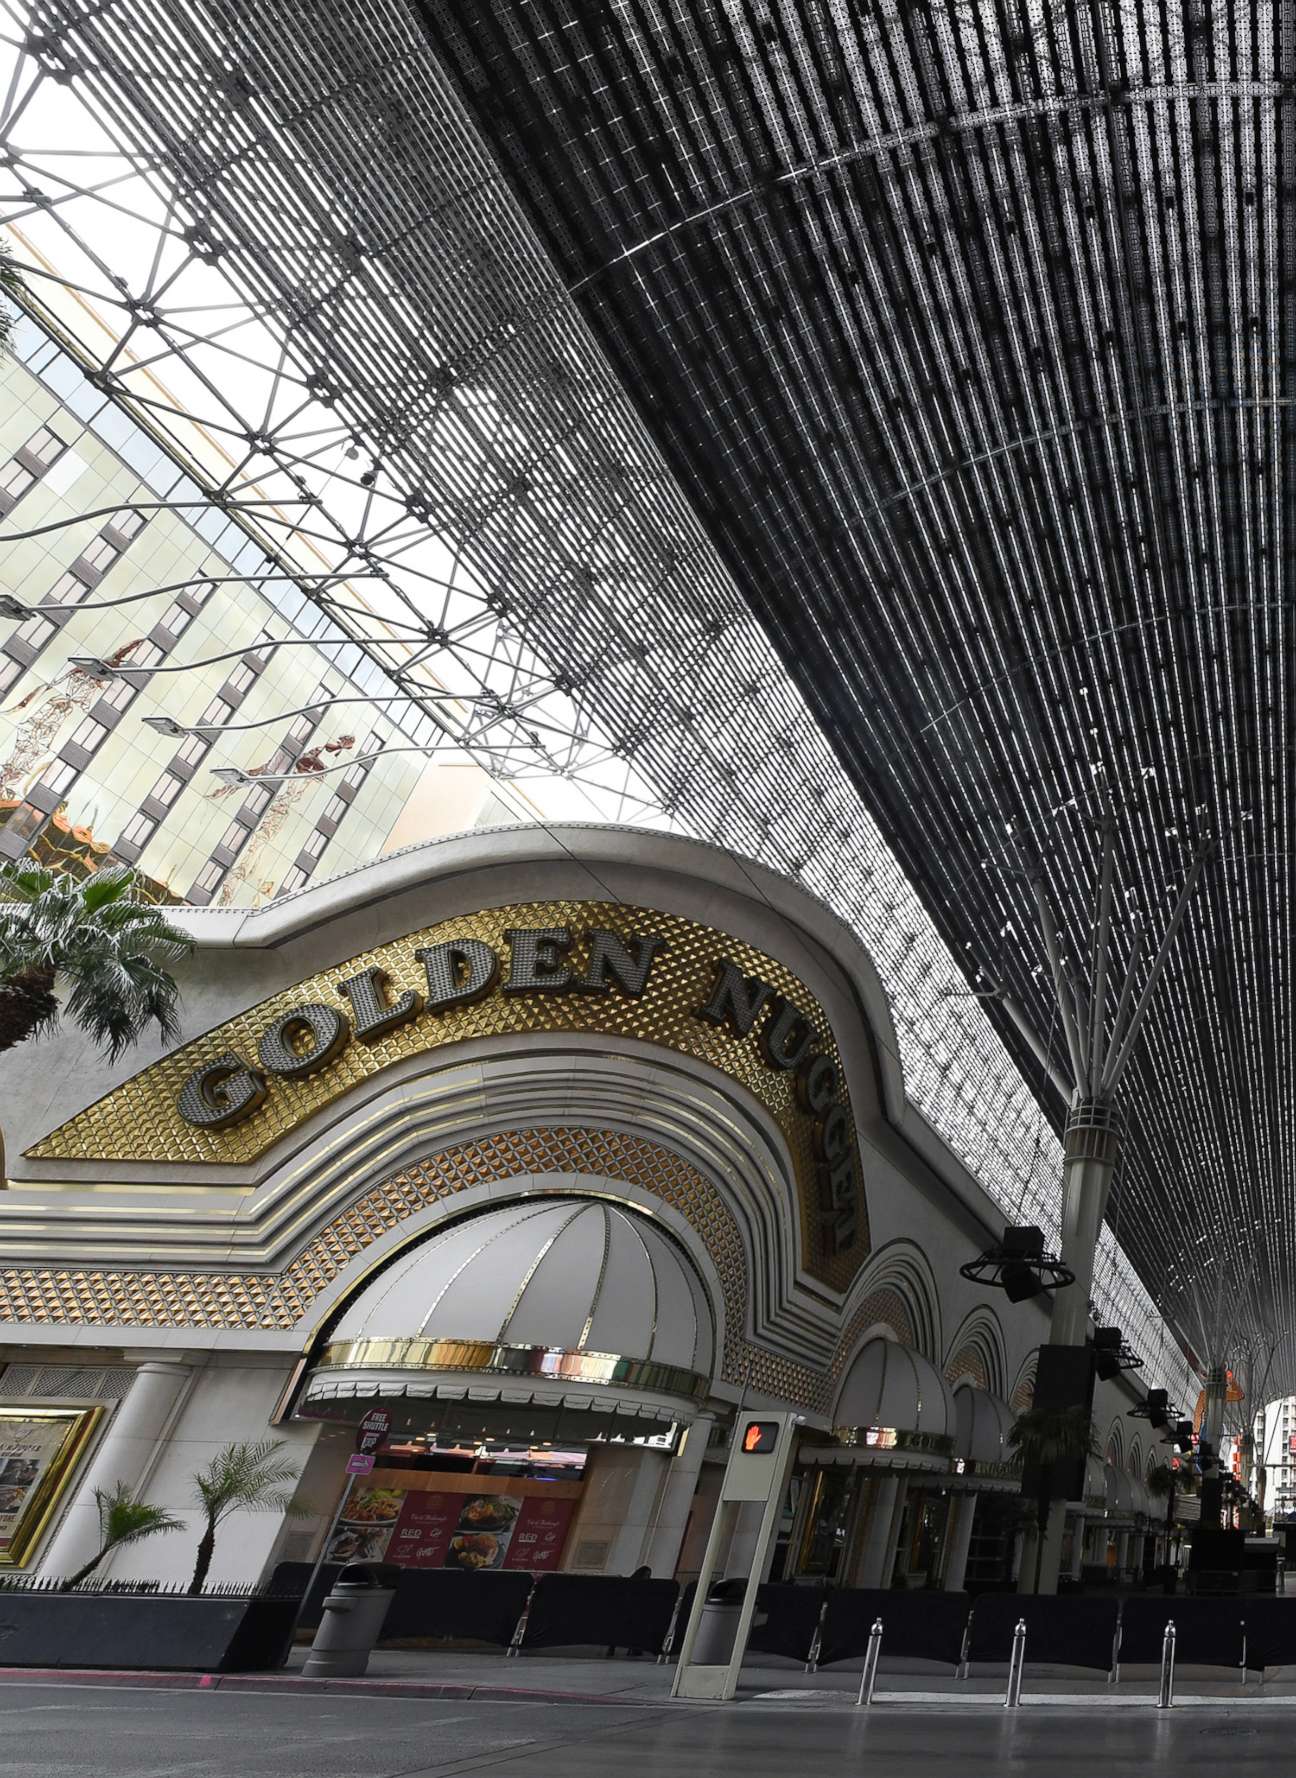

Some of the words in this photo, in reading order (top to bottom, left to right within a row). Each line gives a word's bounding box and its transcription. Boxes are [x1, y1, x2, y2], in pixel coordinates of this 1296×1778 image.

[177, 927, 667, 1130] GOLDEN
[696, 957, 860, 1256] NUGGET
[371, 1412, 388, 1422] FREE
[361, 1420, 390, 1432] SHUTTLE
